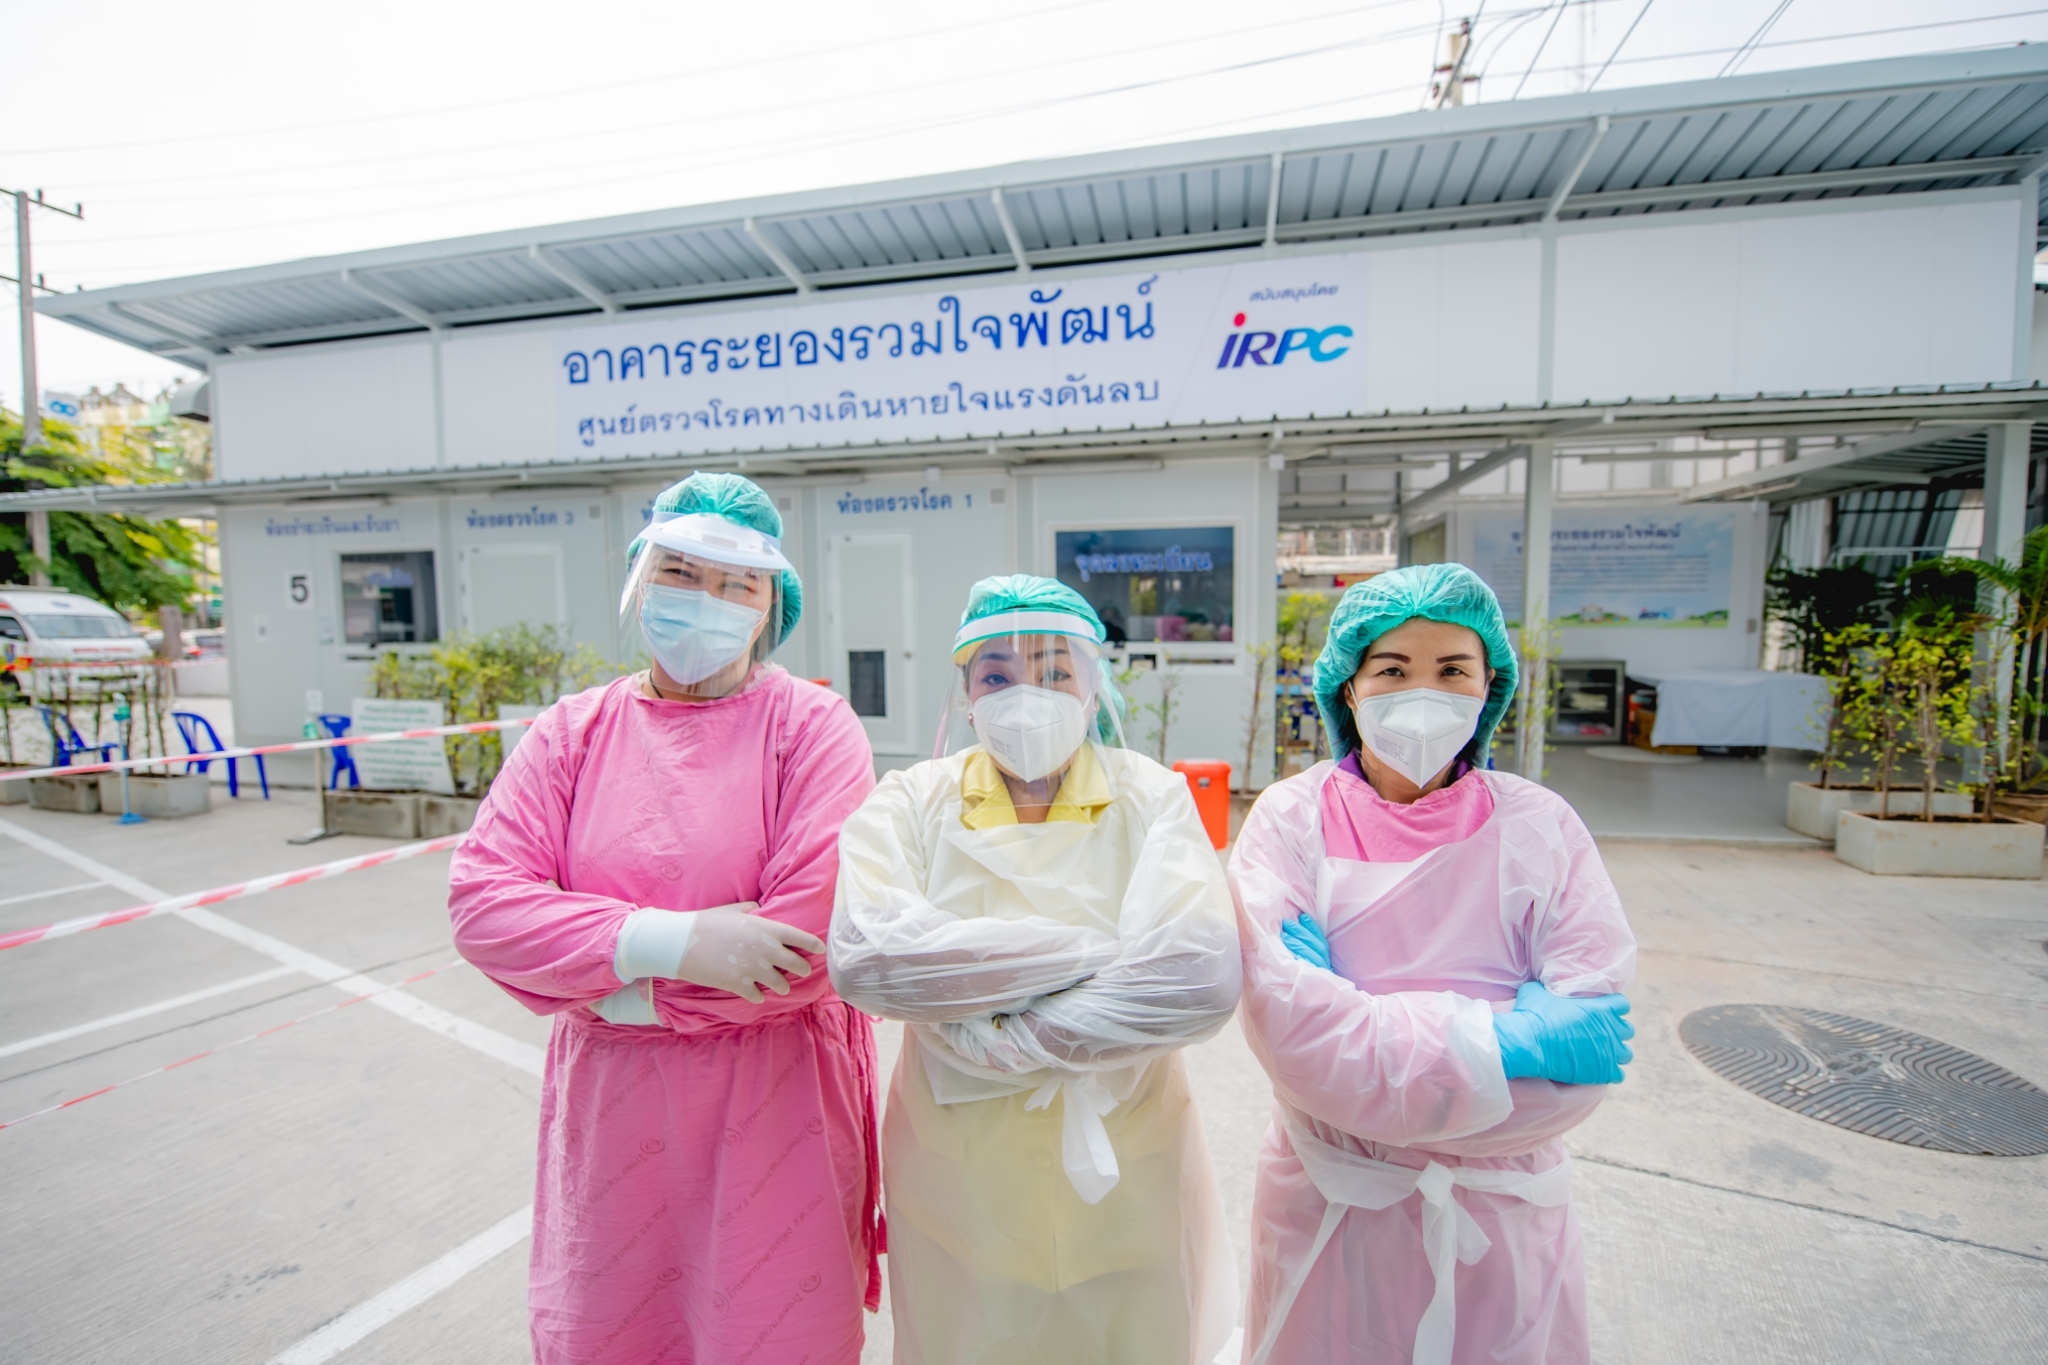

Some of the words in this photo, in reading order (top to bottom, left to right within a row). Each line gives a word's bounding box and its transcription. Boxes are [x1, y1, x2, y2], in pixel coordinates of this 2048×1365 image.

[563, 274, 1159, 384] อาคารระยองรวมใจพัฒน์
[578, 374, 1159, 447] ศูนย์ตรวจโรคทางเดินหายใจแรงดันลบ
[837, 487, 953, 514] ห้องตรวจโรค
[290, 575, 309, 604] 5
